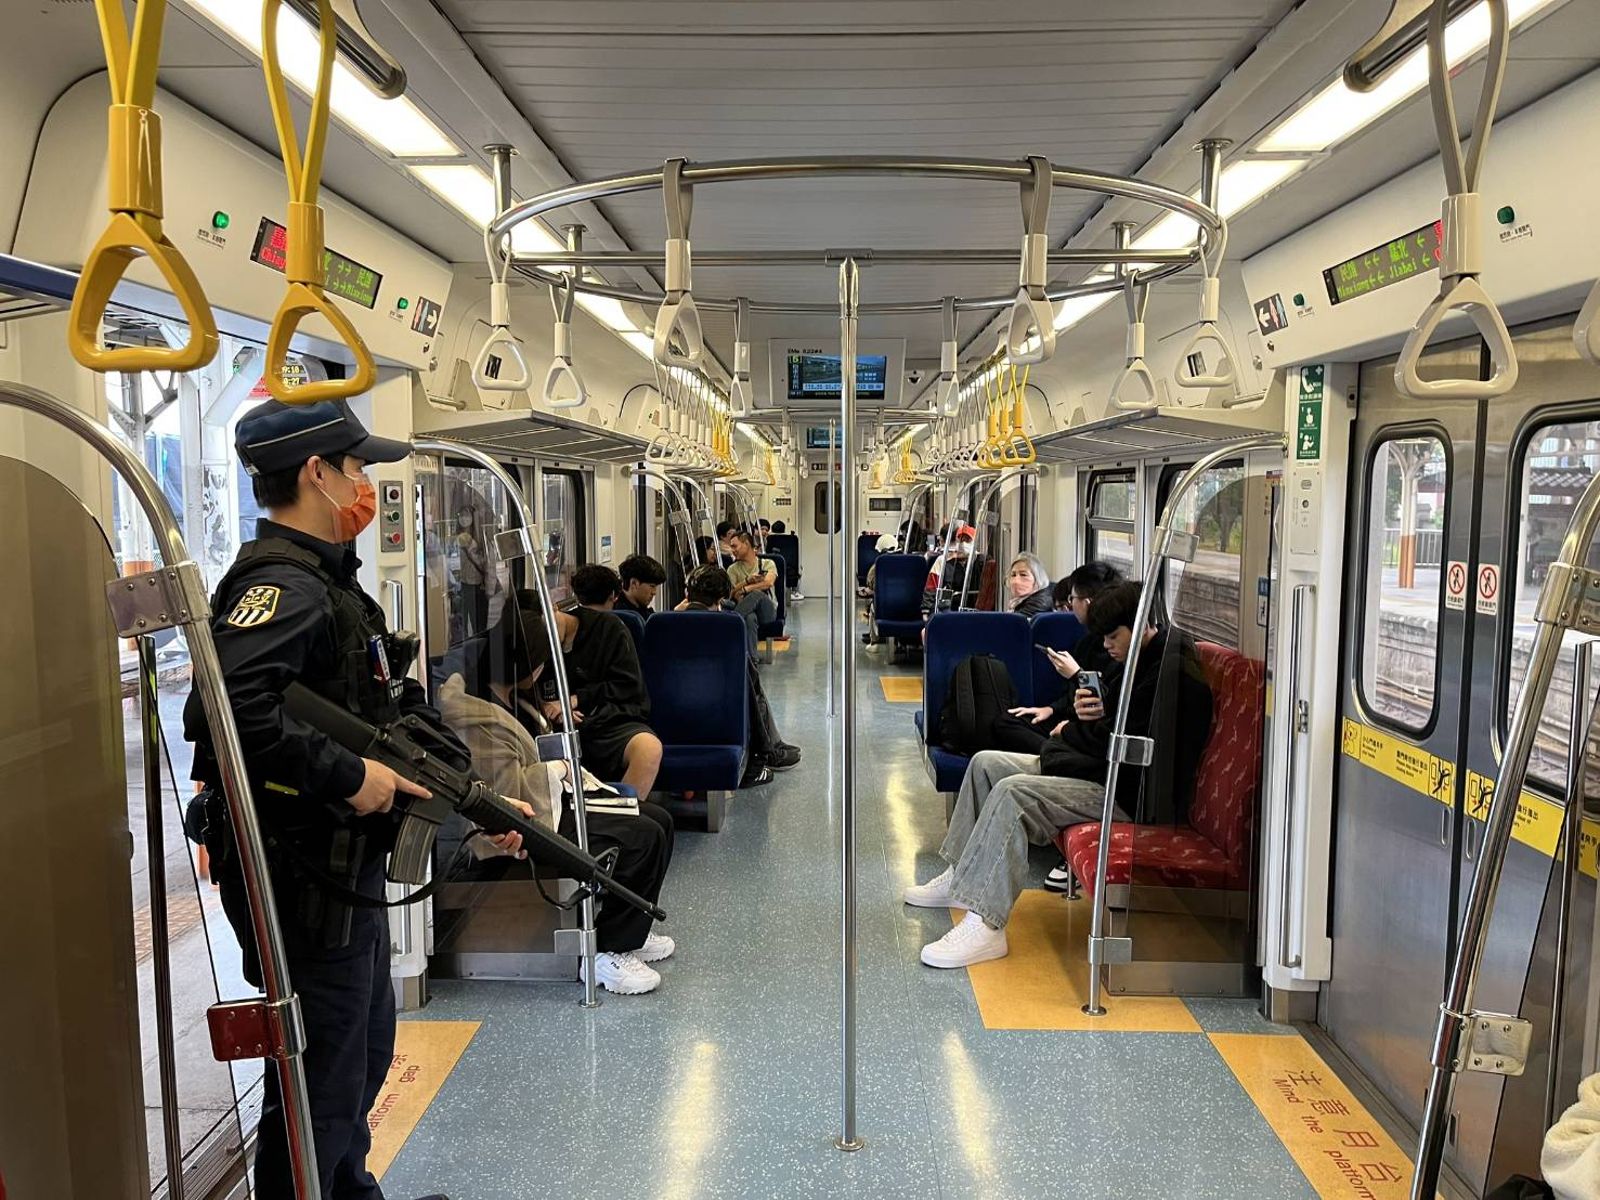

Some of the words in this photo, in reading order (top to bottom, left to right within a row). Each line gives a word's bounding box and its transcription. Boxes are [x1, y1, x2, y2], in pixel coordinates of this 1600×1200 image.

[399, 1065, 421, 1083] gap
[1273, 1078, 1304, 1104] Mind
[1302, 1114, 1324, 1134] the
